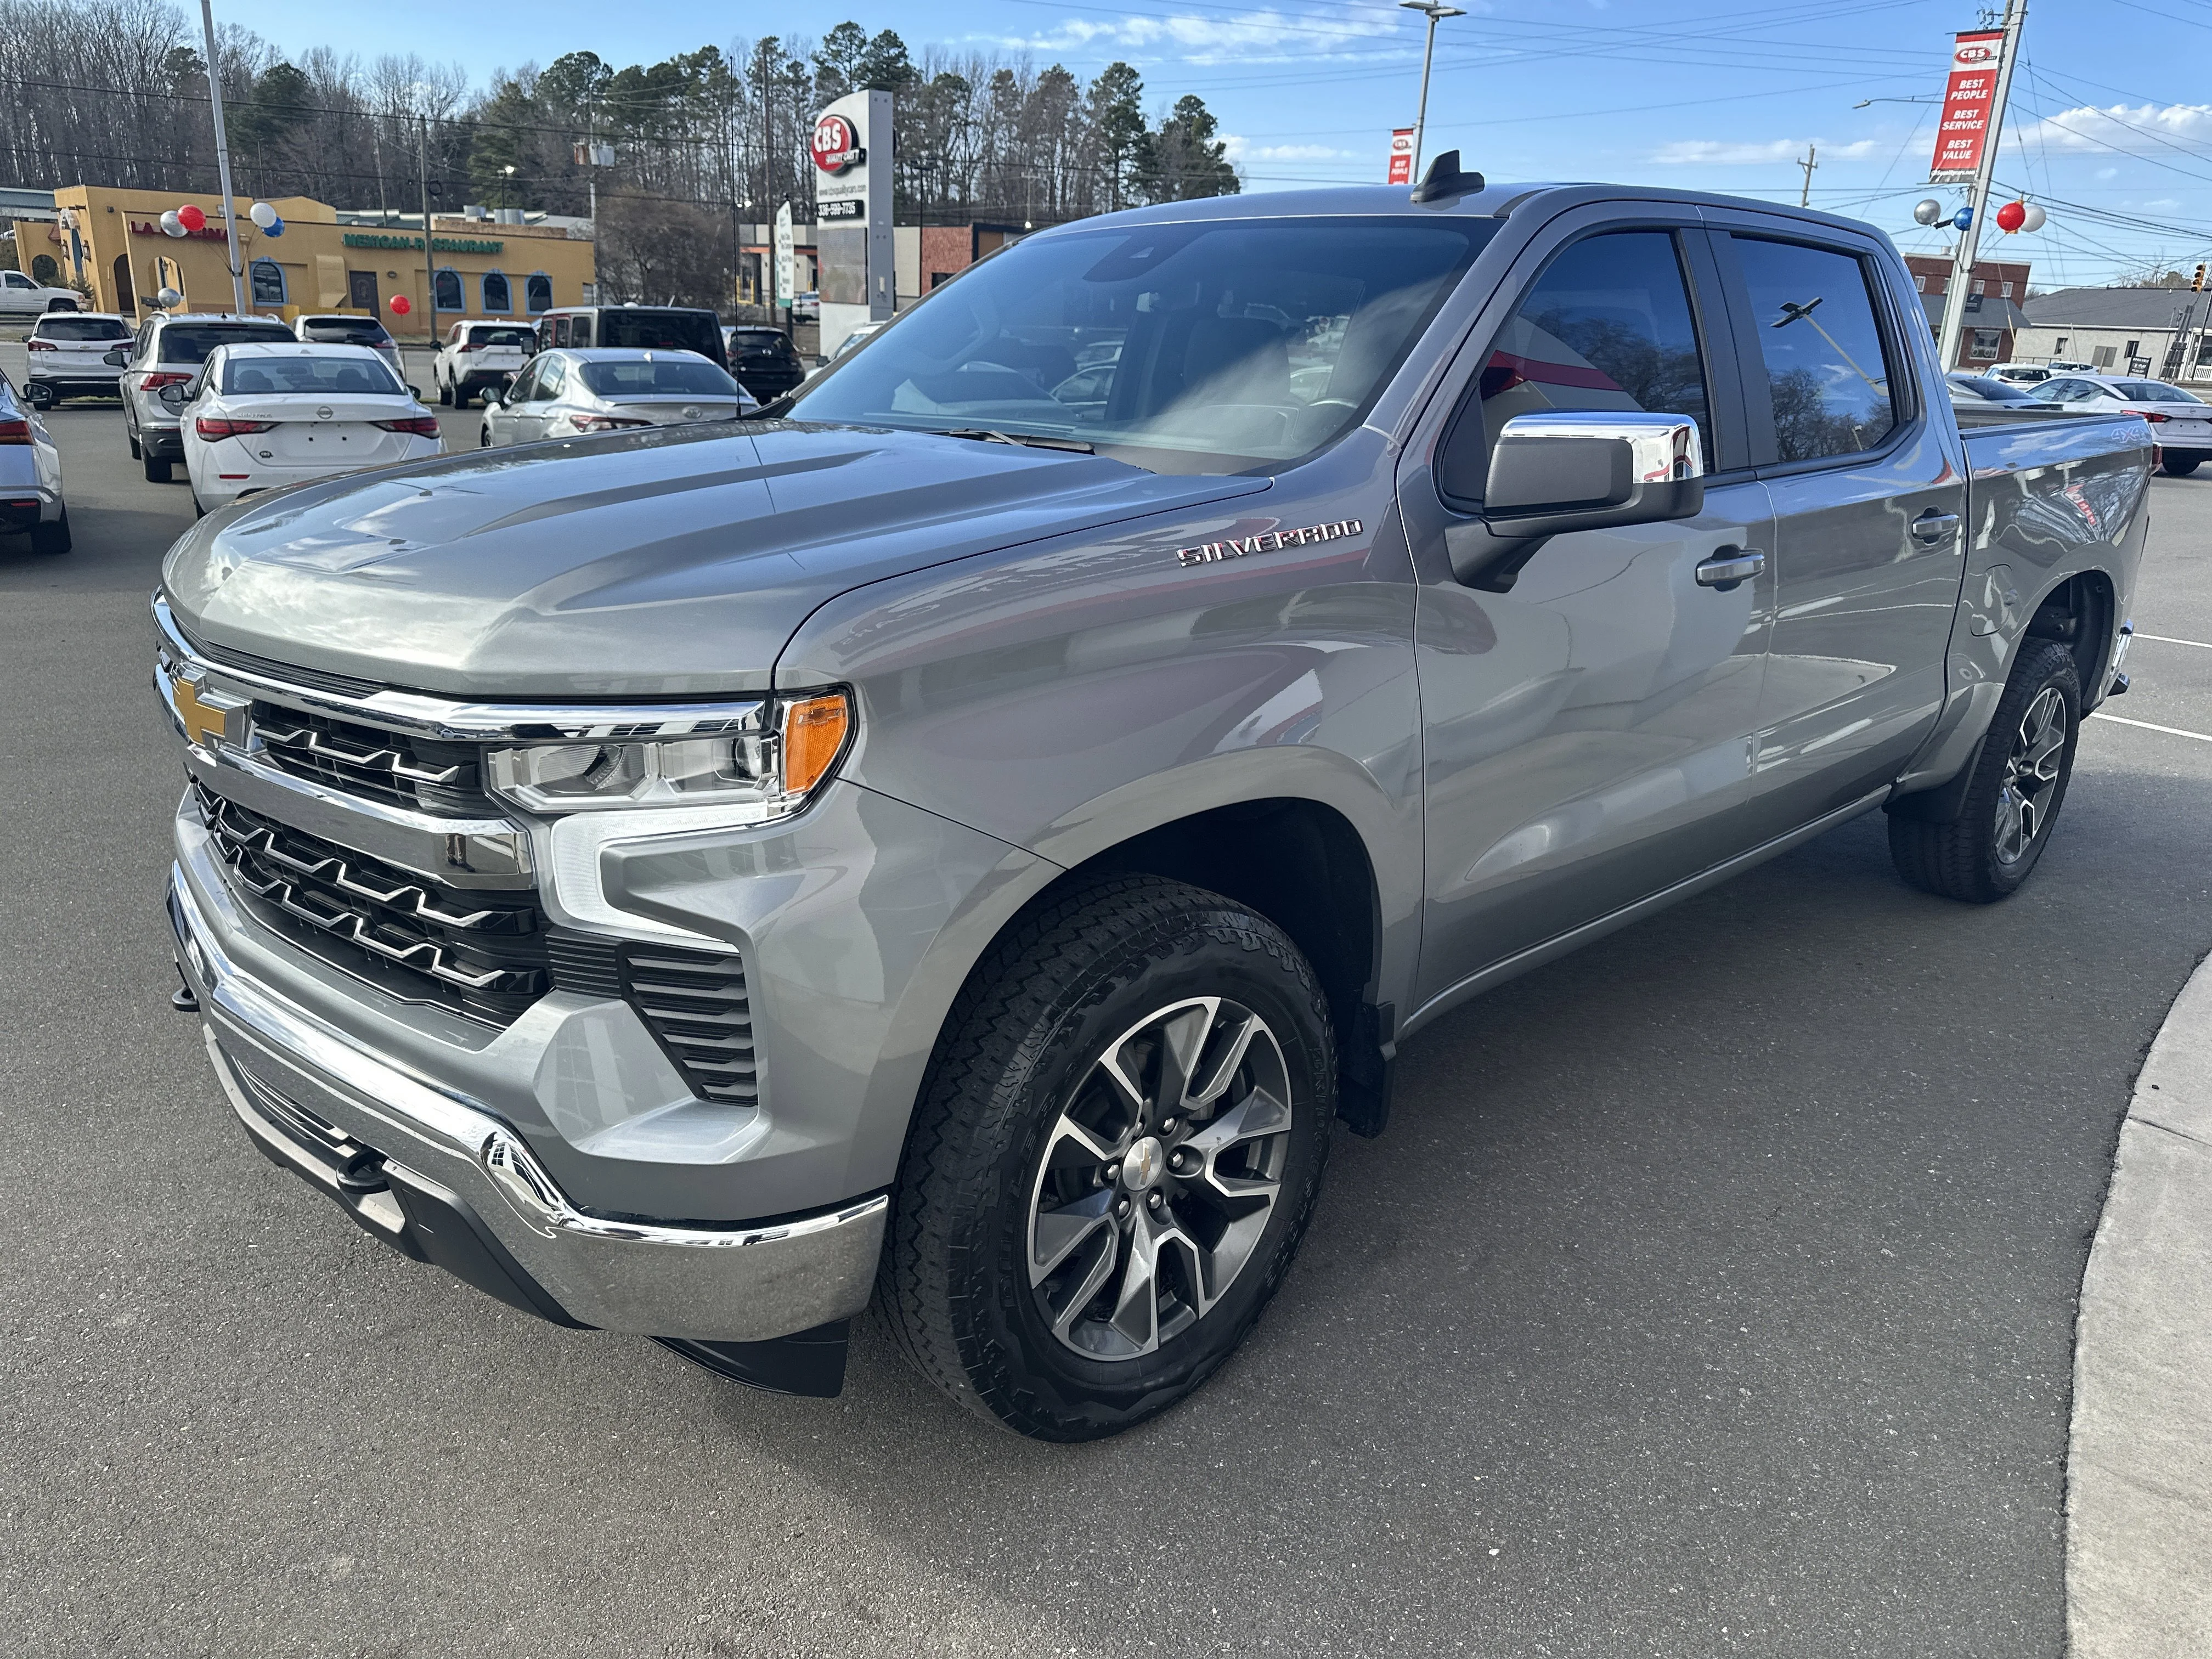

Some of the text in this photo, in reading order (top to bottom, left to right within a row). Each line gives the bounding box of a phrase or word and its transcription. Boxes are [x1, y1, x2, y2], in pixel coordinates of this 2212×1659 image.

[1960, 49, 1985, 59] CBS
[1959, 79, 1985, 89] BEST
[1950, 89, 1988, 100] PEOPLE
[1953, 109, 1979, 119] BEST
[1942, 120, 1984, 131] SERVICE
[814, 122, 842, 153] CBS
[1947, 139, 1973, 149] BEST
[1943, 150, 1973, 160] VALUE
[342, 233, 504, 253] MEXICAN RSTAURANT
[1176, 518, 1364, 568] SILVERADO
